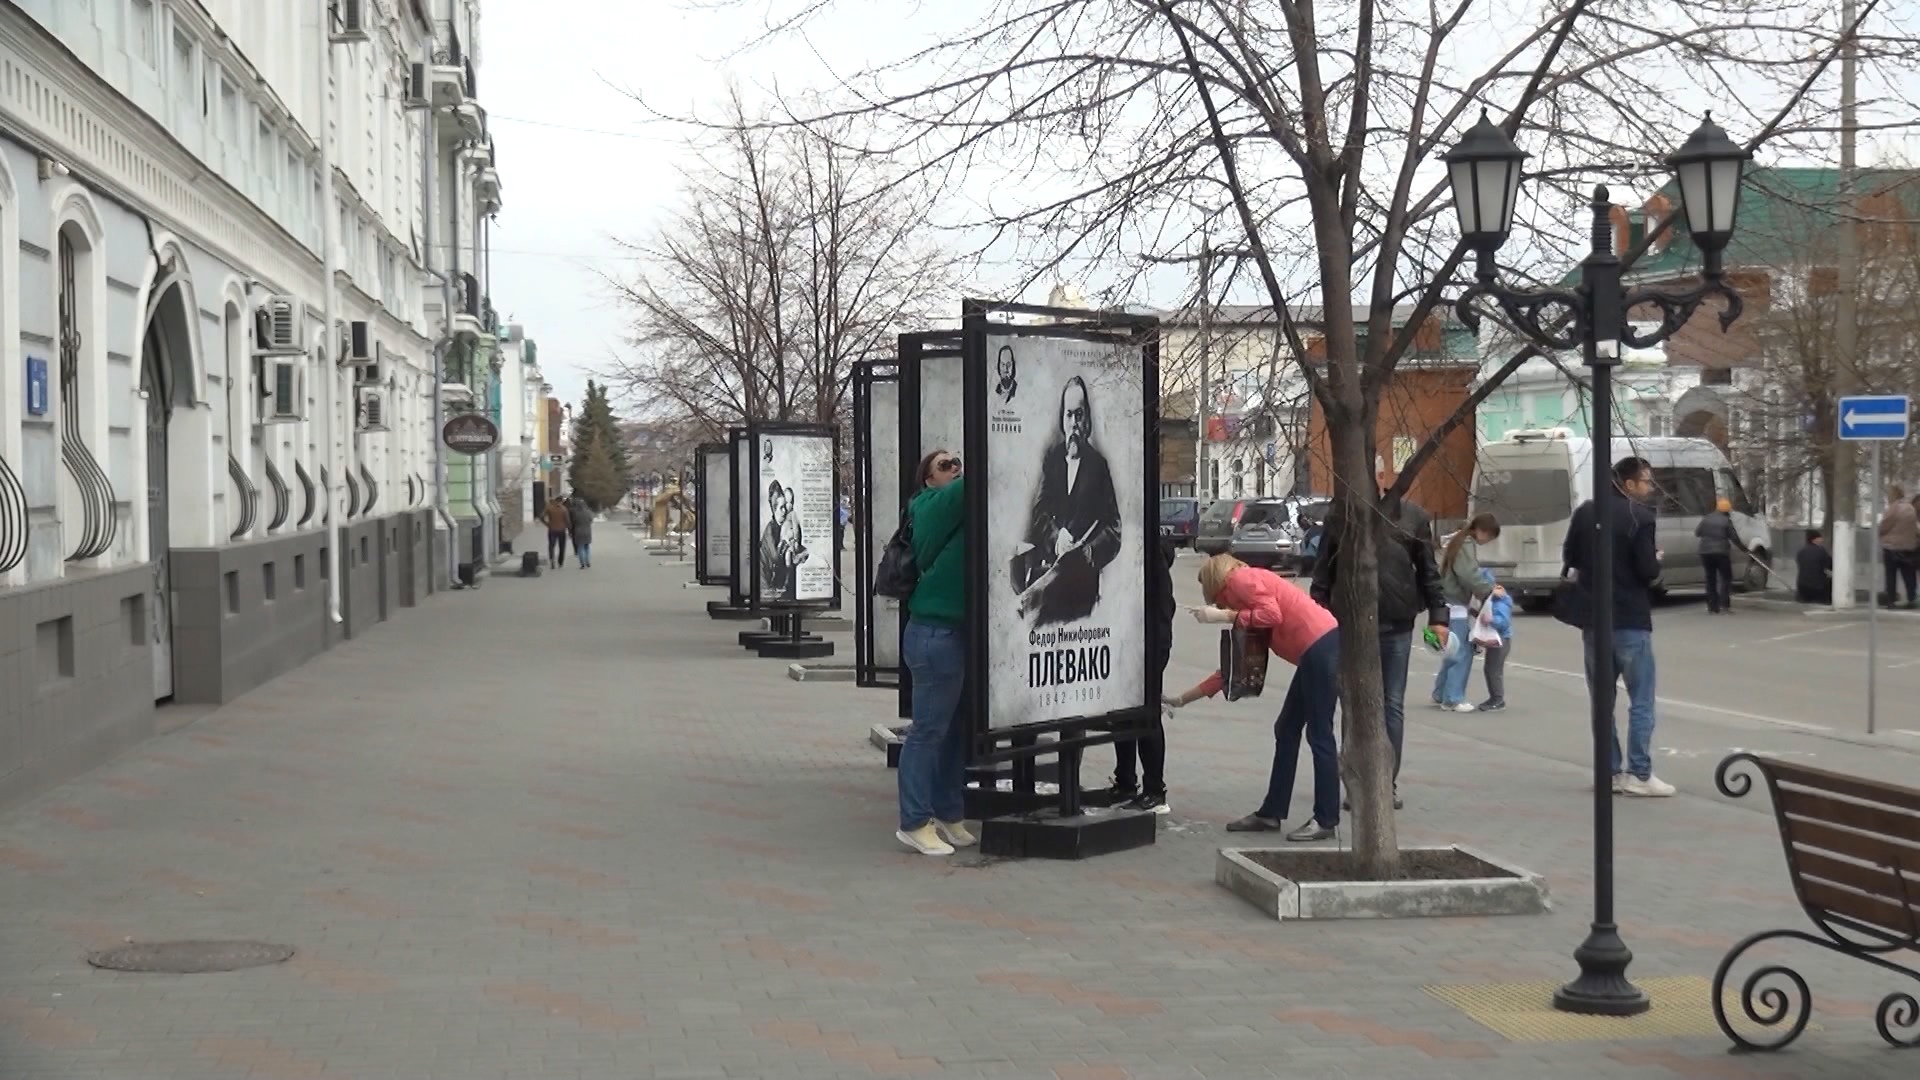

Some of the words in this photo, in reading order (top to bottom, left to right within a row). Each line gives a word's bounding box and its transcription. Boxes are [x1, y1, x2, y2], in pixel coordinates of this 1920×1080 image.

[1028, 629, 1056, 648] Федор
[1057, 625, 1111, 644] Никифорович
[1028, 644, 1111, 688] ПЛЕВАКО
